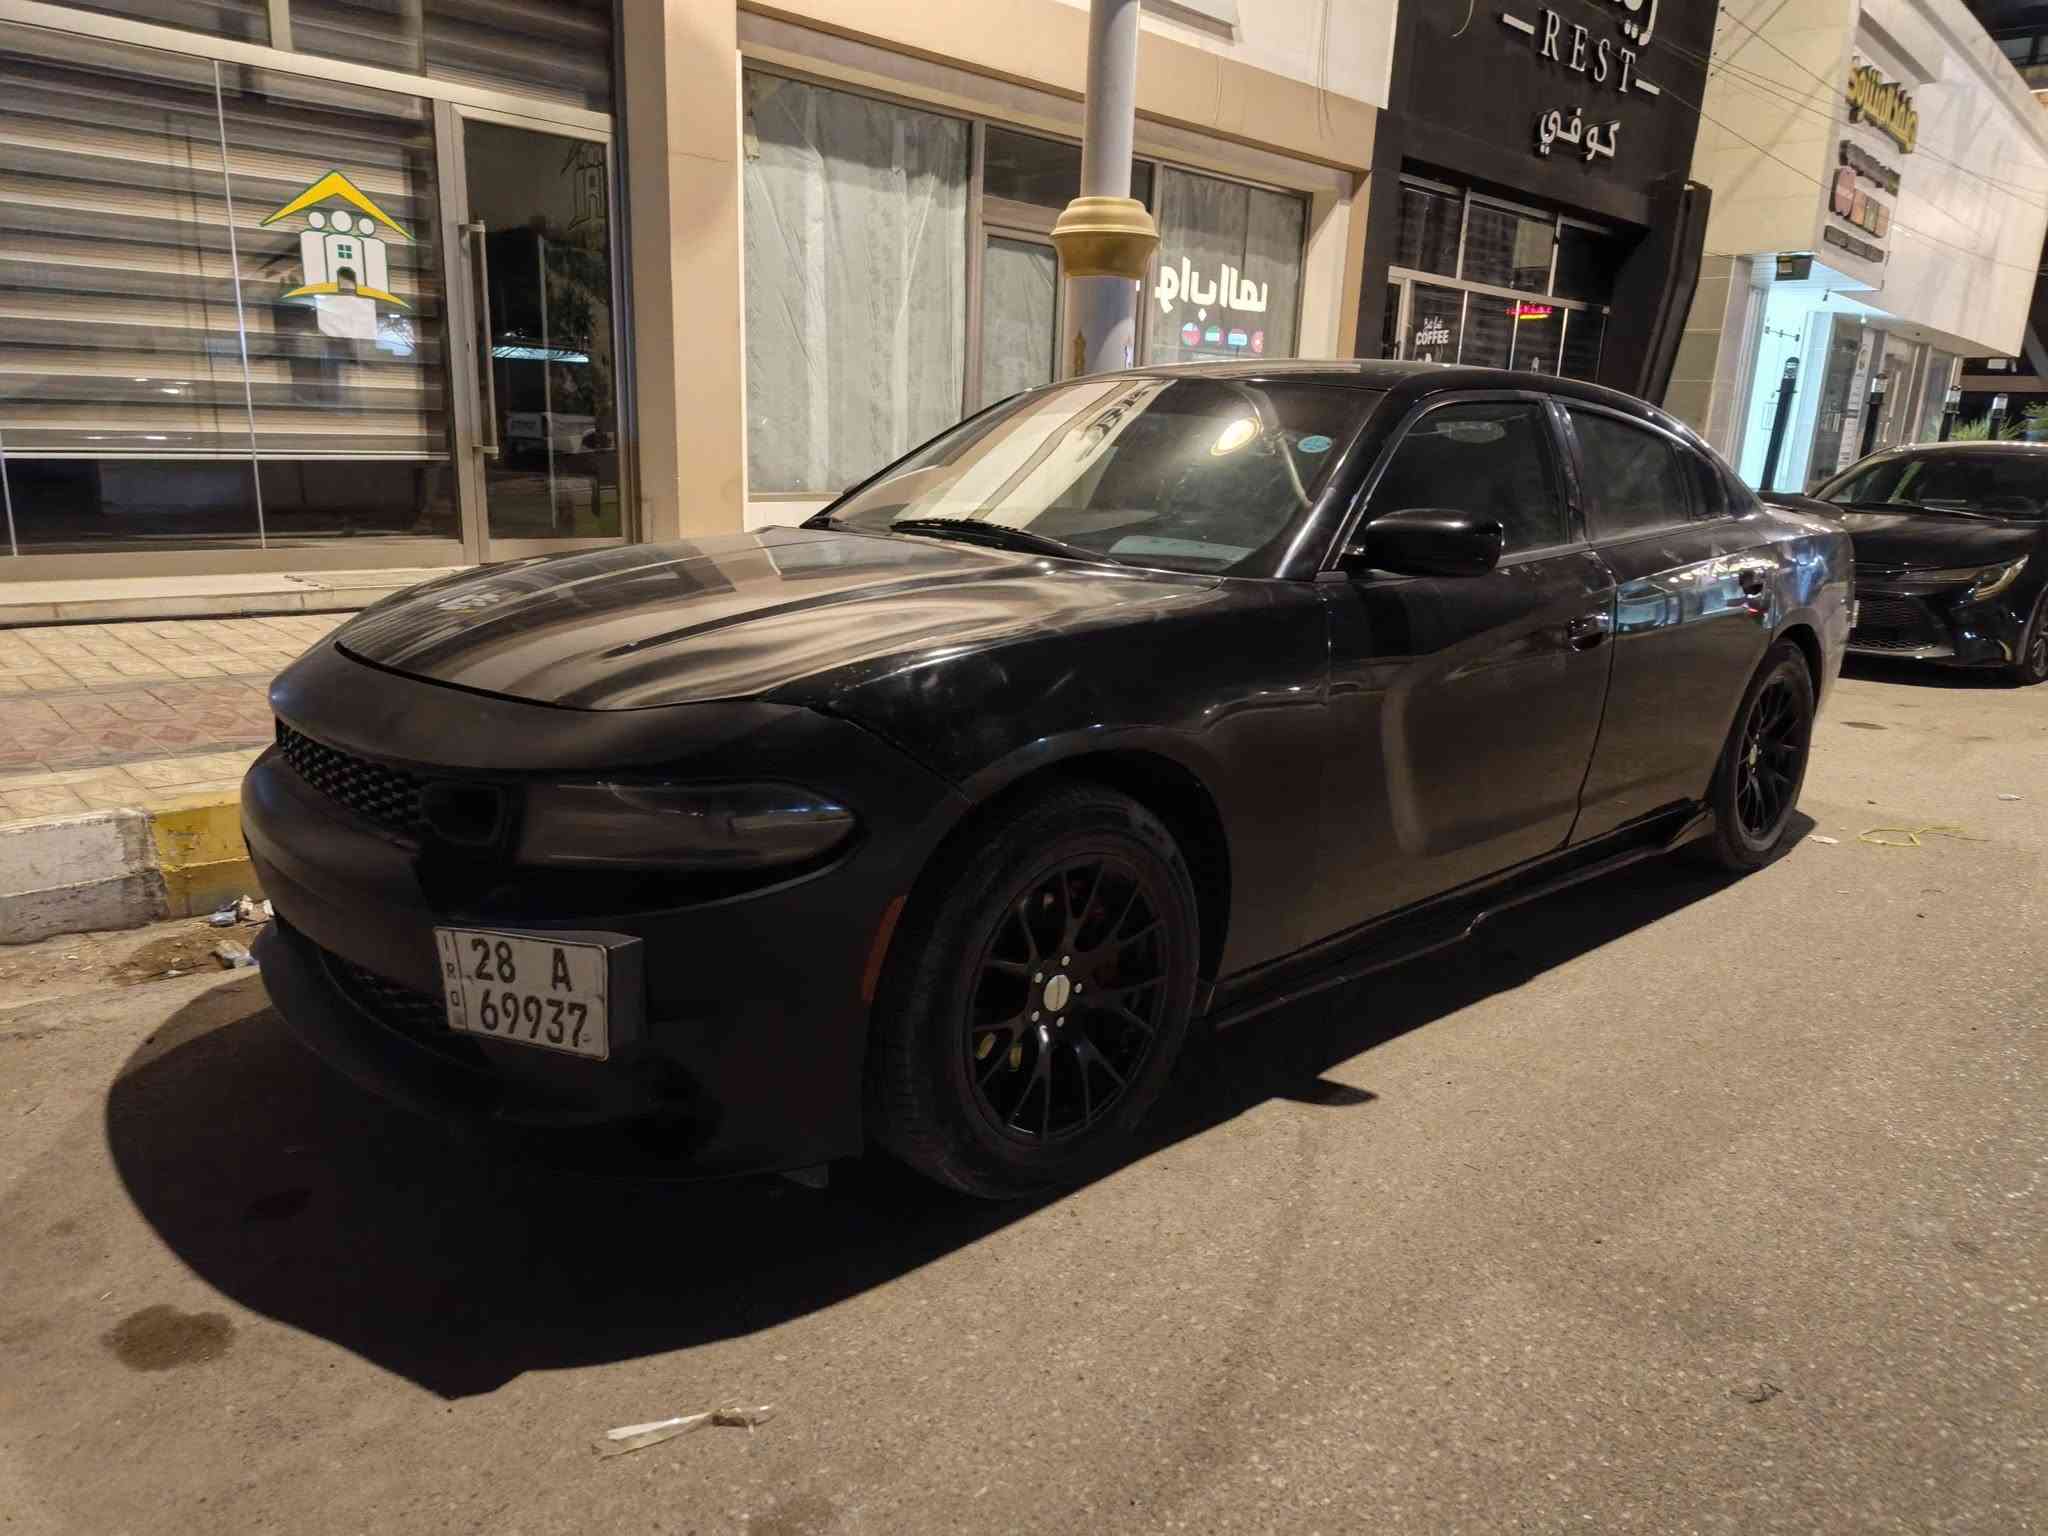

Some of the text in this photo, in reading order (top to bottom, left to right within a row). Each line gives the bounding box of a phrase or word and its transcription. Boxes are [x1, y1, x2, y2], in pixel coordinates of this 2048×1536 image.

[1540, 9, 1636, 93] REST
[1416, 329, 1449, 345] COFFEE
[471, 938, 573, 992] 28 A
[480, 989, 588, 1047] 69937
